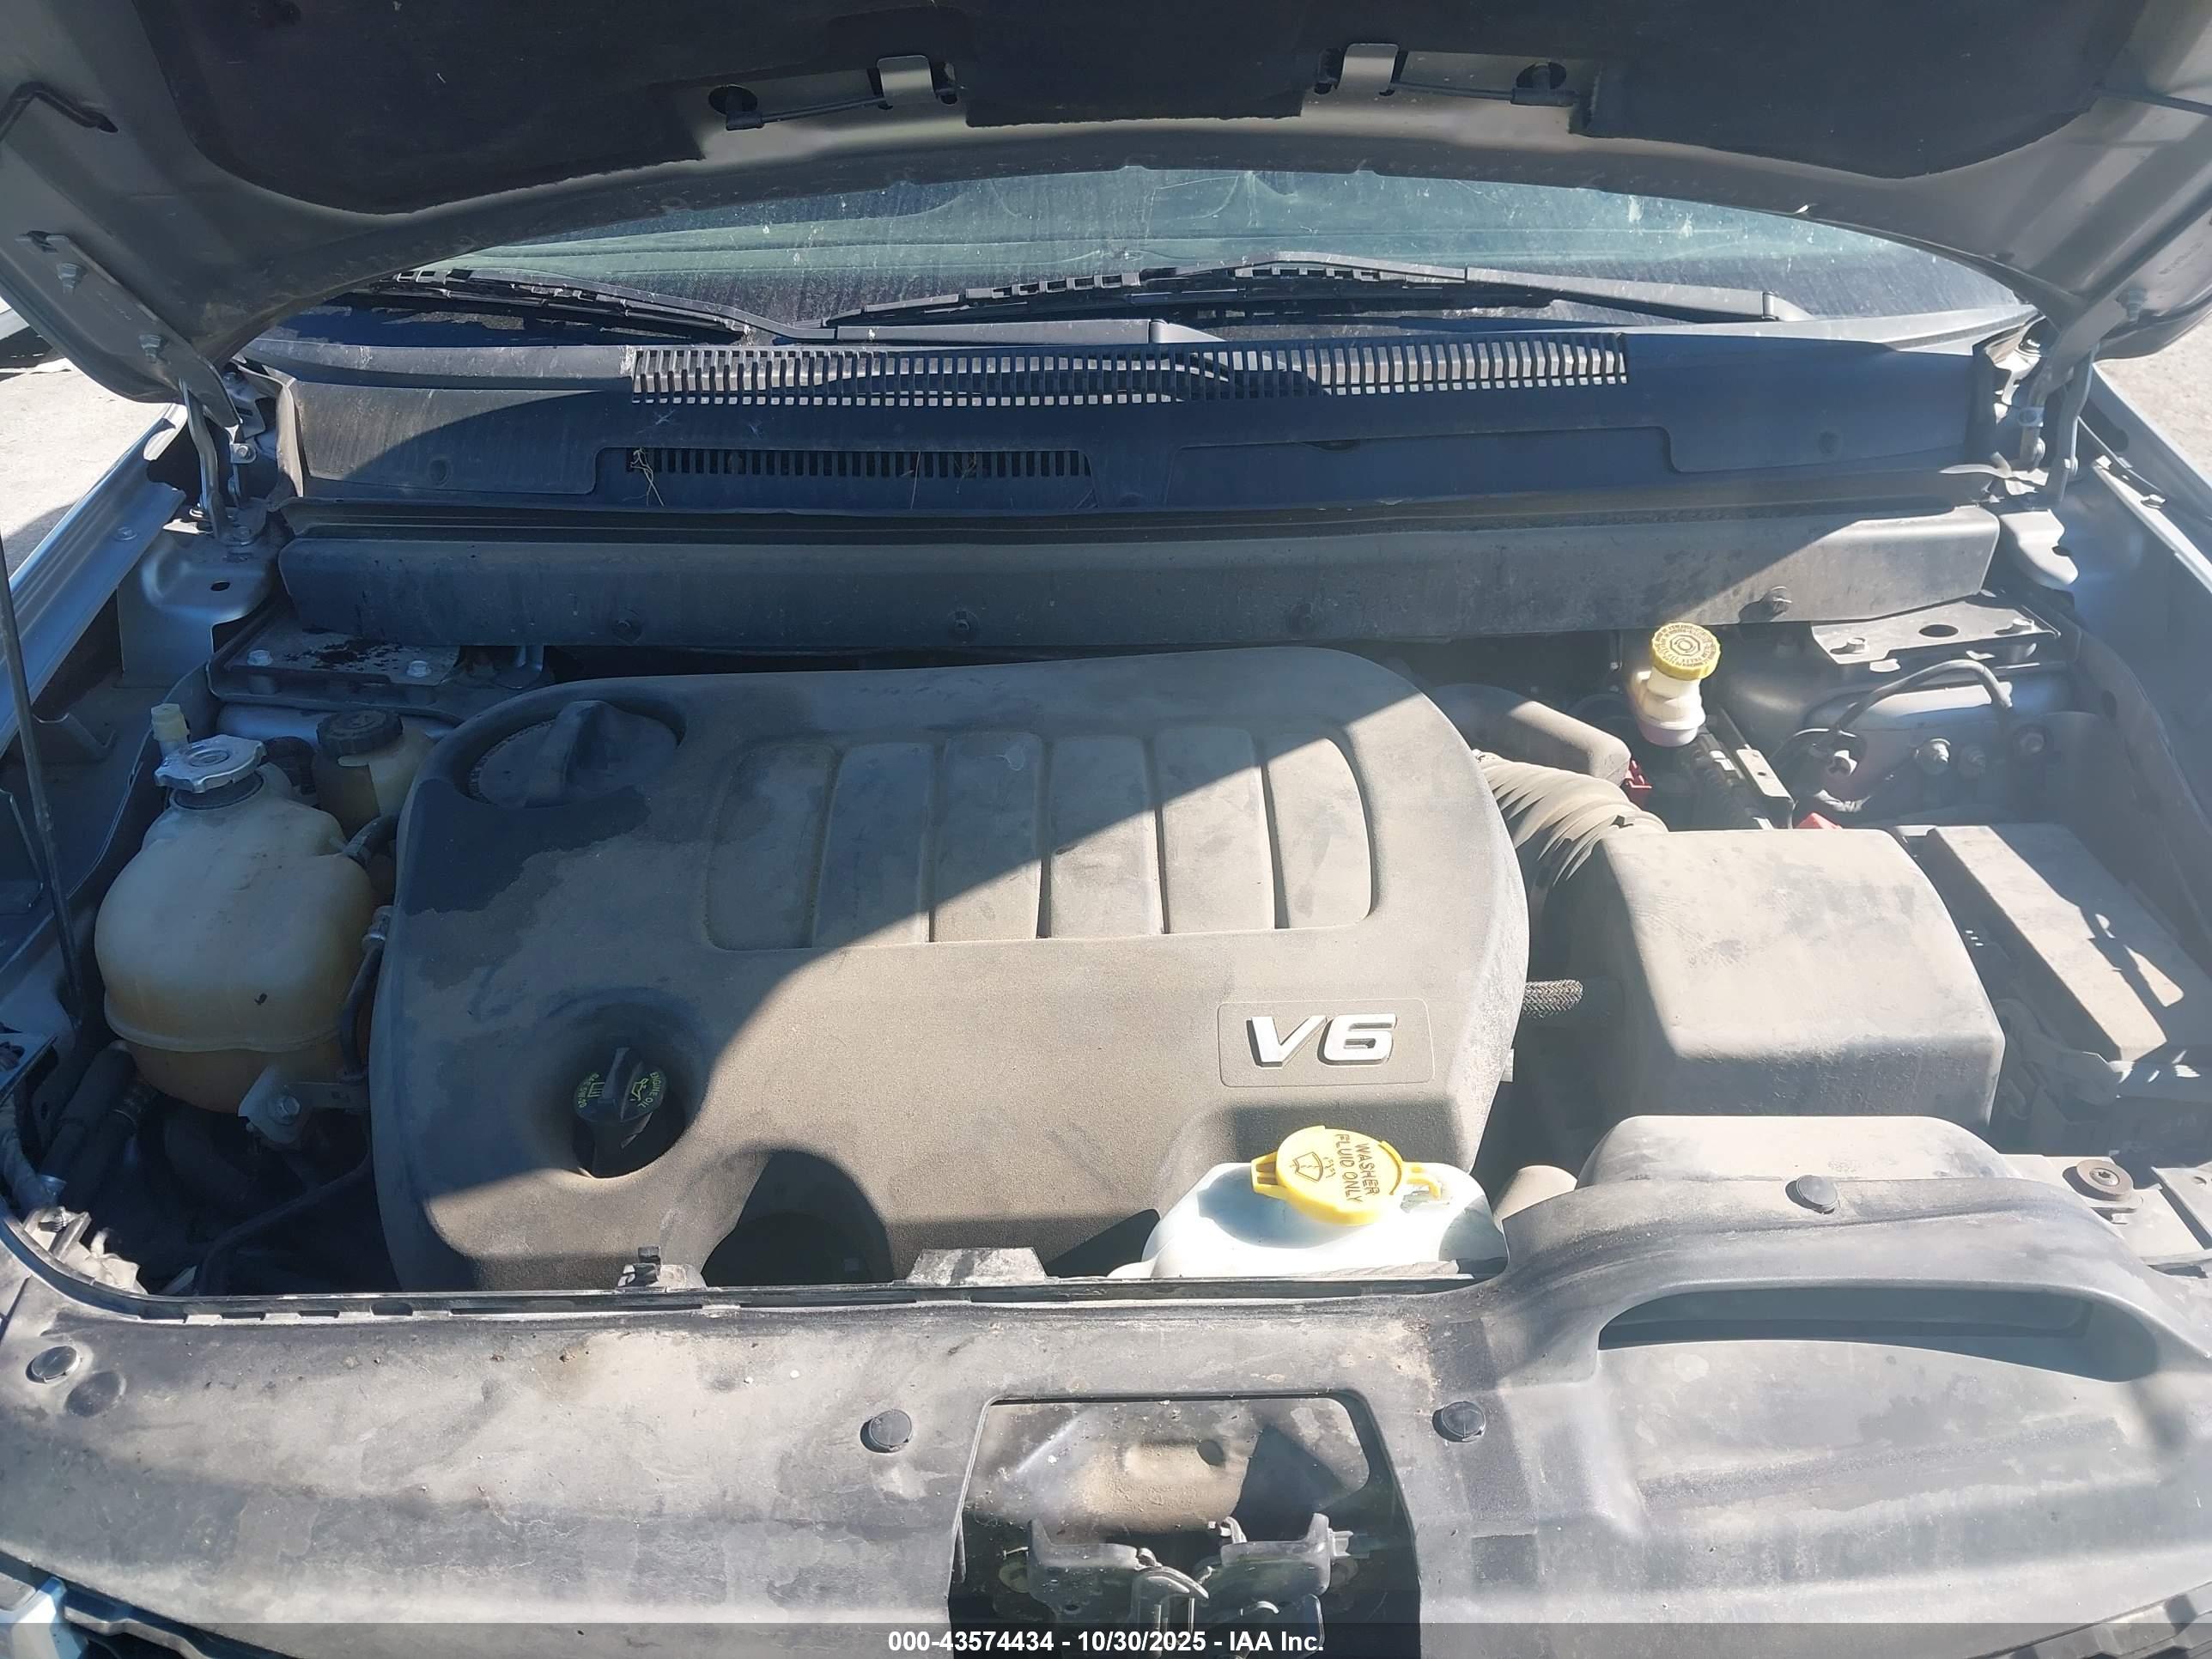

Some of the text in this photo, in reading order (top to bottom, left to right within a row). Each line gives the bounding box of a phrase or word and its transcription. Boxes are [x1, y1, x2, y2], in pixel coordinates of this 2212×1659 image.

[1247, 1013, 1397, 1067] V6
[637, 1071, 661, 1109] ENGINE OIL
[1334, 1133, 1364, 1203] FLUID ONLY
[1354, 1143, 1382, 1196] WASHER
